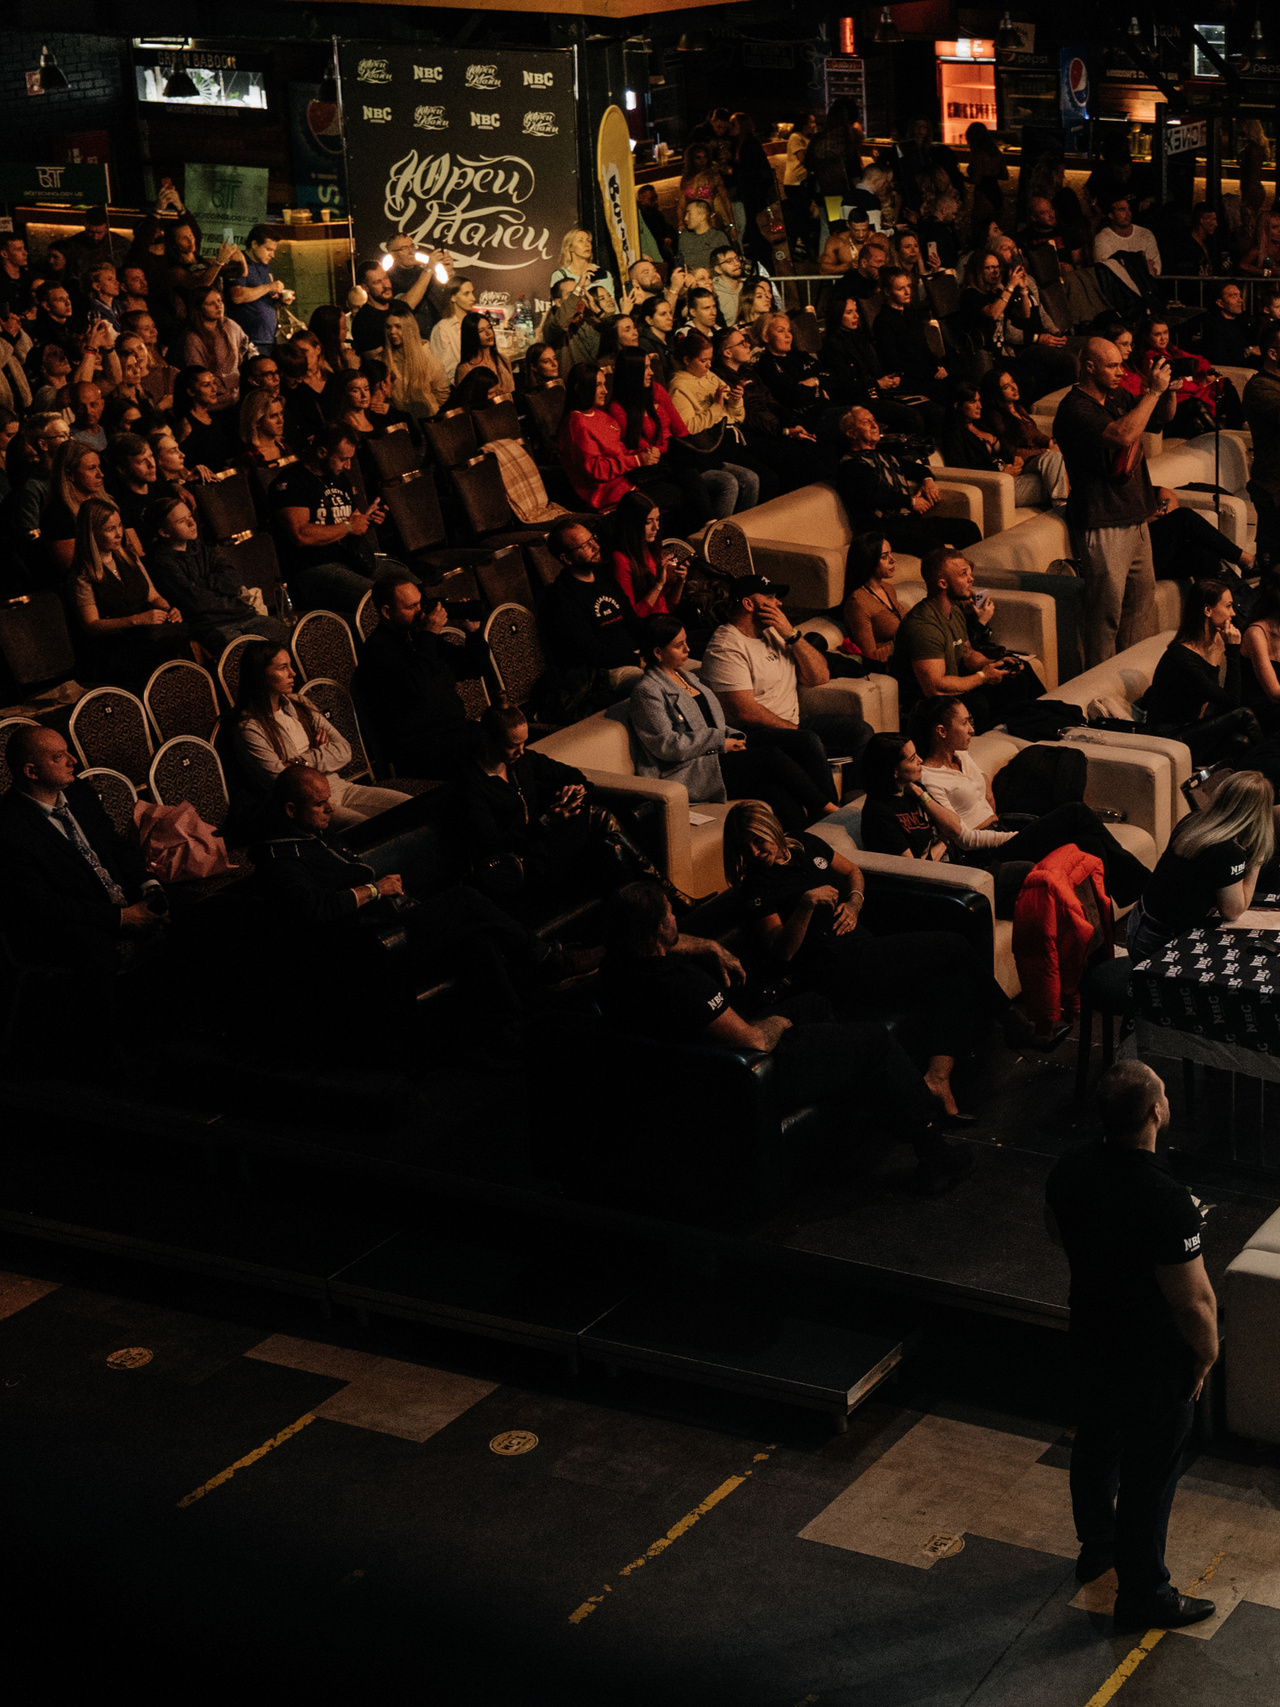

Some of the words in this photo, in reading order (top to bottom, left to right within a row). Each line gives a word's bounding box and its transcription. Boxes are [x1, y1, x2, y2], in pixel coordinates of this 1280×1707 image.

[413, 65, 443, 80] NBC
[522, 70, 553, 86] NBC
[362, 105, 392, 120] NBC
[470, 112, 500, 127] NBC
